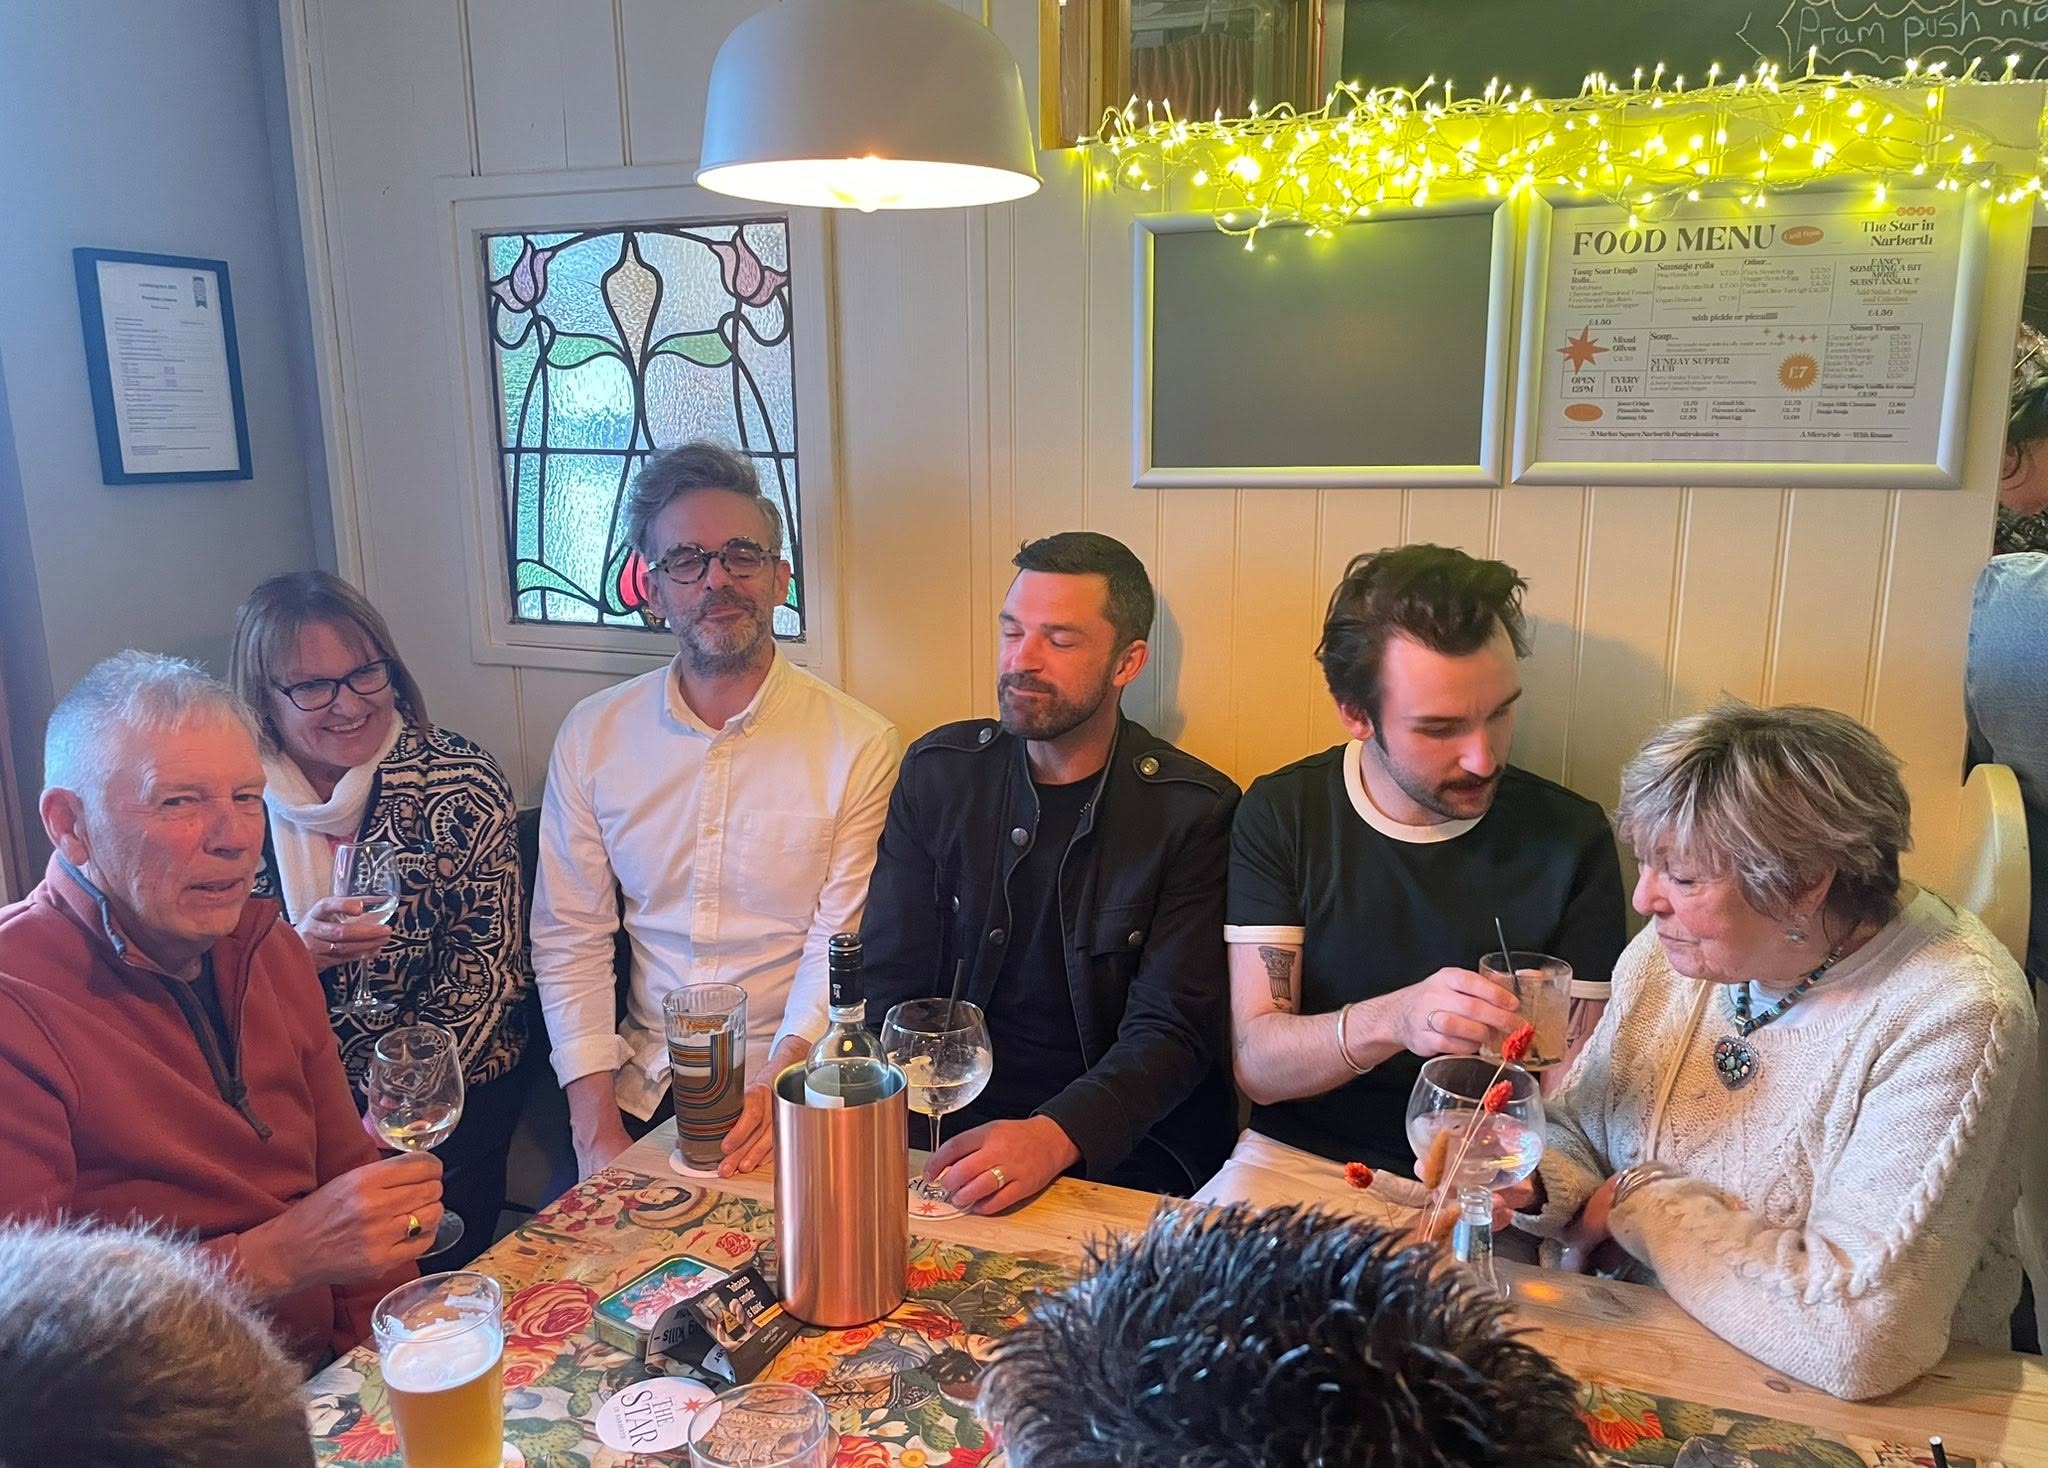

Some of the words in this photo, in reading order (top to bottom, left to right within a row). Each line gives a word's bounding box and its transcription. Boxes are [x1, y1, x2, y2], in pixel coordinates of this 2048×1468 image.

[1797, 7, 1885, 53] Pram
[1904, 0, 1981, 58] push
[1861, 221, 1887, 233] The
[1889, 220, 1918, 232] Star
[1921, 219, 1935, 231] in
[1573, 229, 1667, 256] FOOD
[1676, 224, 1776, 252] MENU
[1870, 234, 1933, 247] Narberth
[1613, 266, 1638, 276] Dough
[1657, 262, 1693, 271] Sausage
[1695, 261, 1715, 270] rolls
[1612, 336, 1636, 344] Mixed
[1612, 344, 1636, 352] Olives
[1692, 357, 1730, 365] SUPPER
[1650, 365, 1675, 373] CLUB
[1788, 365, 1808, 379] £7
[1571, 376, 1596, 384] OPEN
[1610, 376, 1640, 384] EVERY
[1571, 385, 1595, 393] 12PM
[1615, 385, 1634, 393] DAY
[726, 1276, 750, 1292] Tobacco
[739, 1288, 756, 1305] smoke
[744, 1308, 753, 1318] is
[750, 1301, 765, 1315] toxic
[662, 1325, 686, 1344] kills
[620, 1390, 658, 1447] STAR
[652, 1397, 674, 1427] THE
